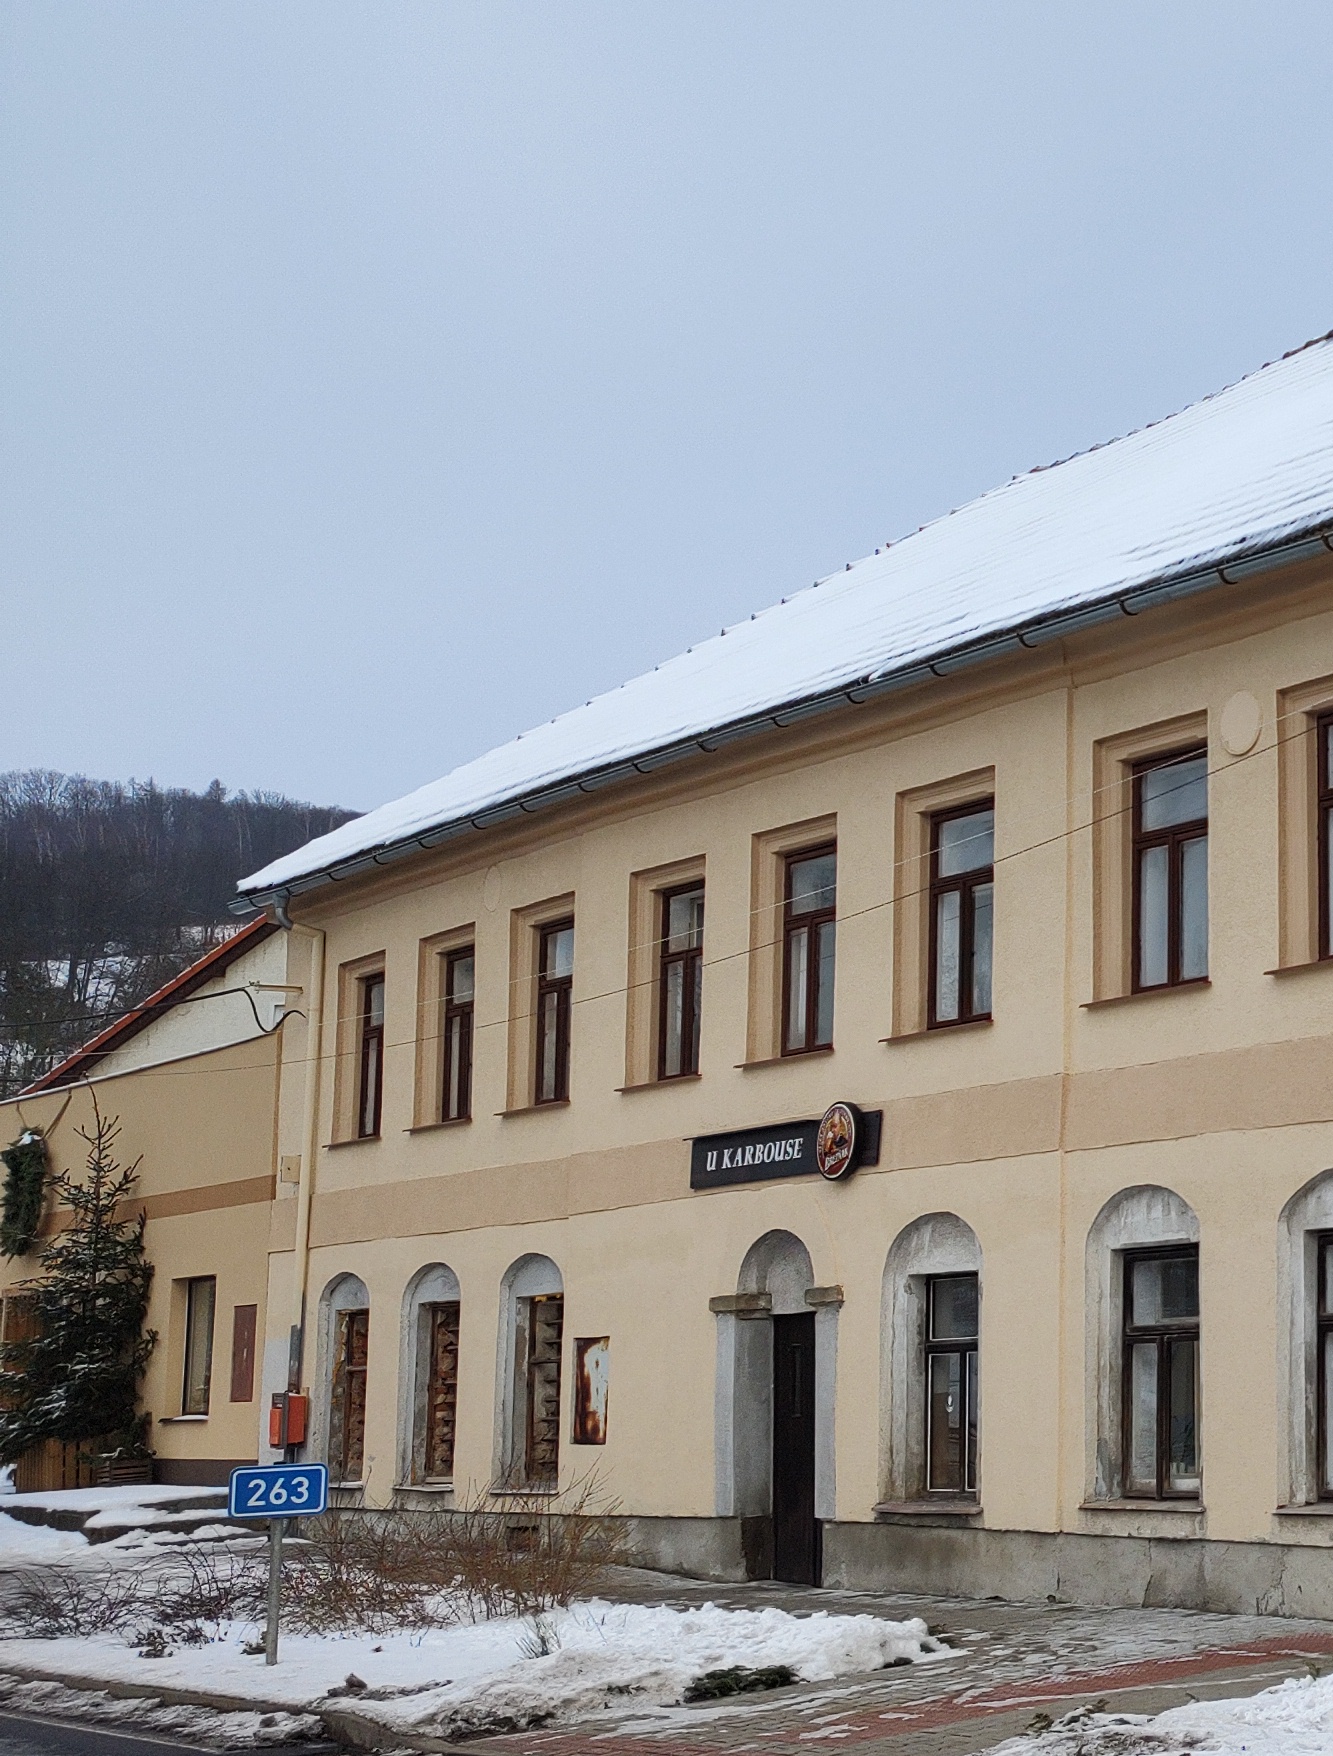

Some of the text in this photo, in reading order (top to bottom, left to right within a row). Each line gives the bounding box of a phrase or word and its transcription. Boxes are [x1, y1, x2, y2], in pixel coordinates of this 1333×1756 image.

[706, 1138, 804, 1172] U KARBOUSE
[247, 1476, 310, 1507] 263
